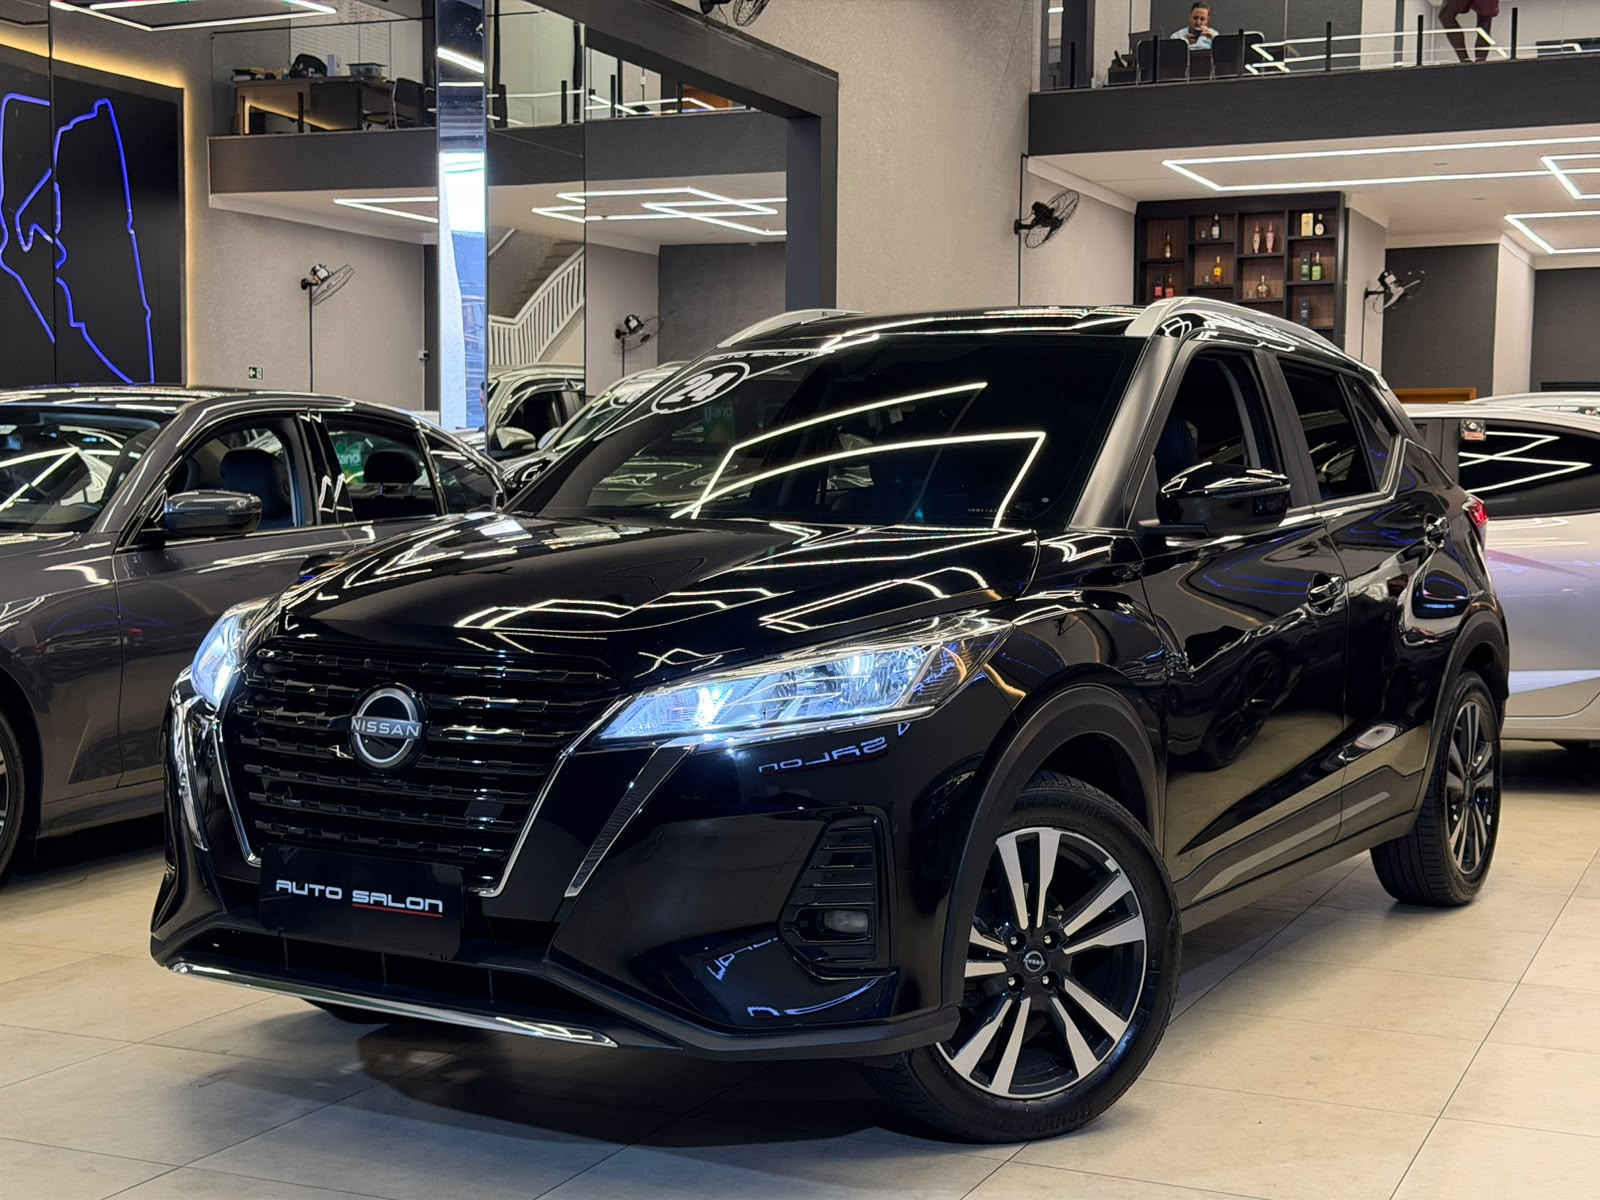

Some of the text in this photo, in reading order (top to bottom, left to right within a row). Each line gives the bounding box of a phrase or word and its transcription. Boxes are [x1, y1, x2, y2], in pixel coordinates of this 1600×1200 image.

[659, 371, 739, 404] 24
[351, 718, 420, 737] NISSAN
[276, 879, 443, 913] AUTO SALON
